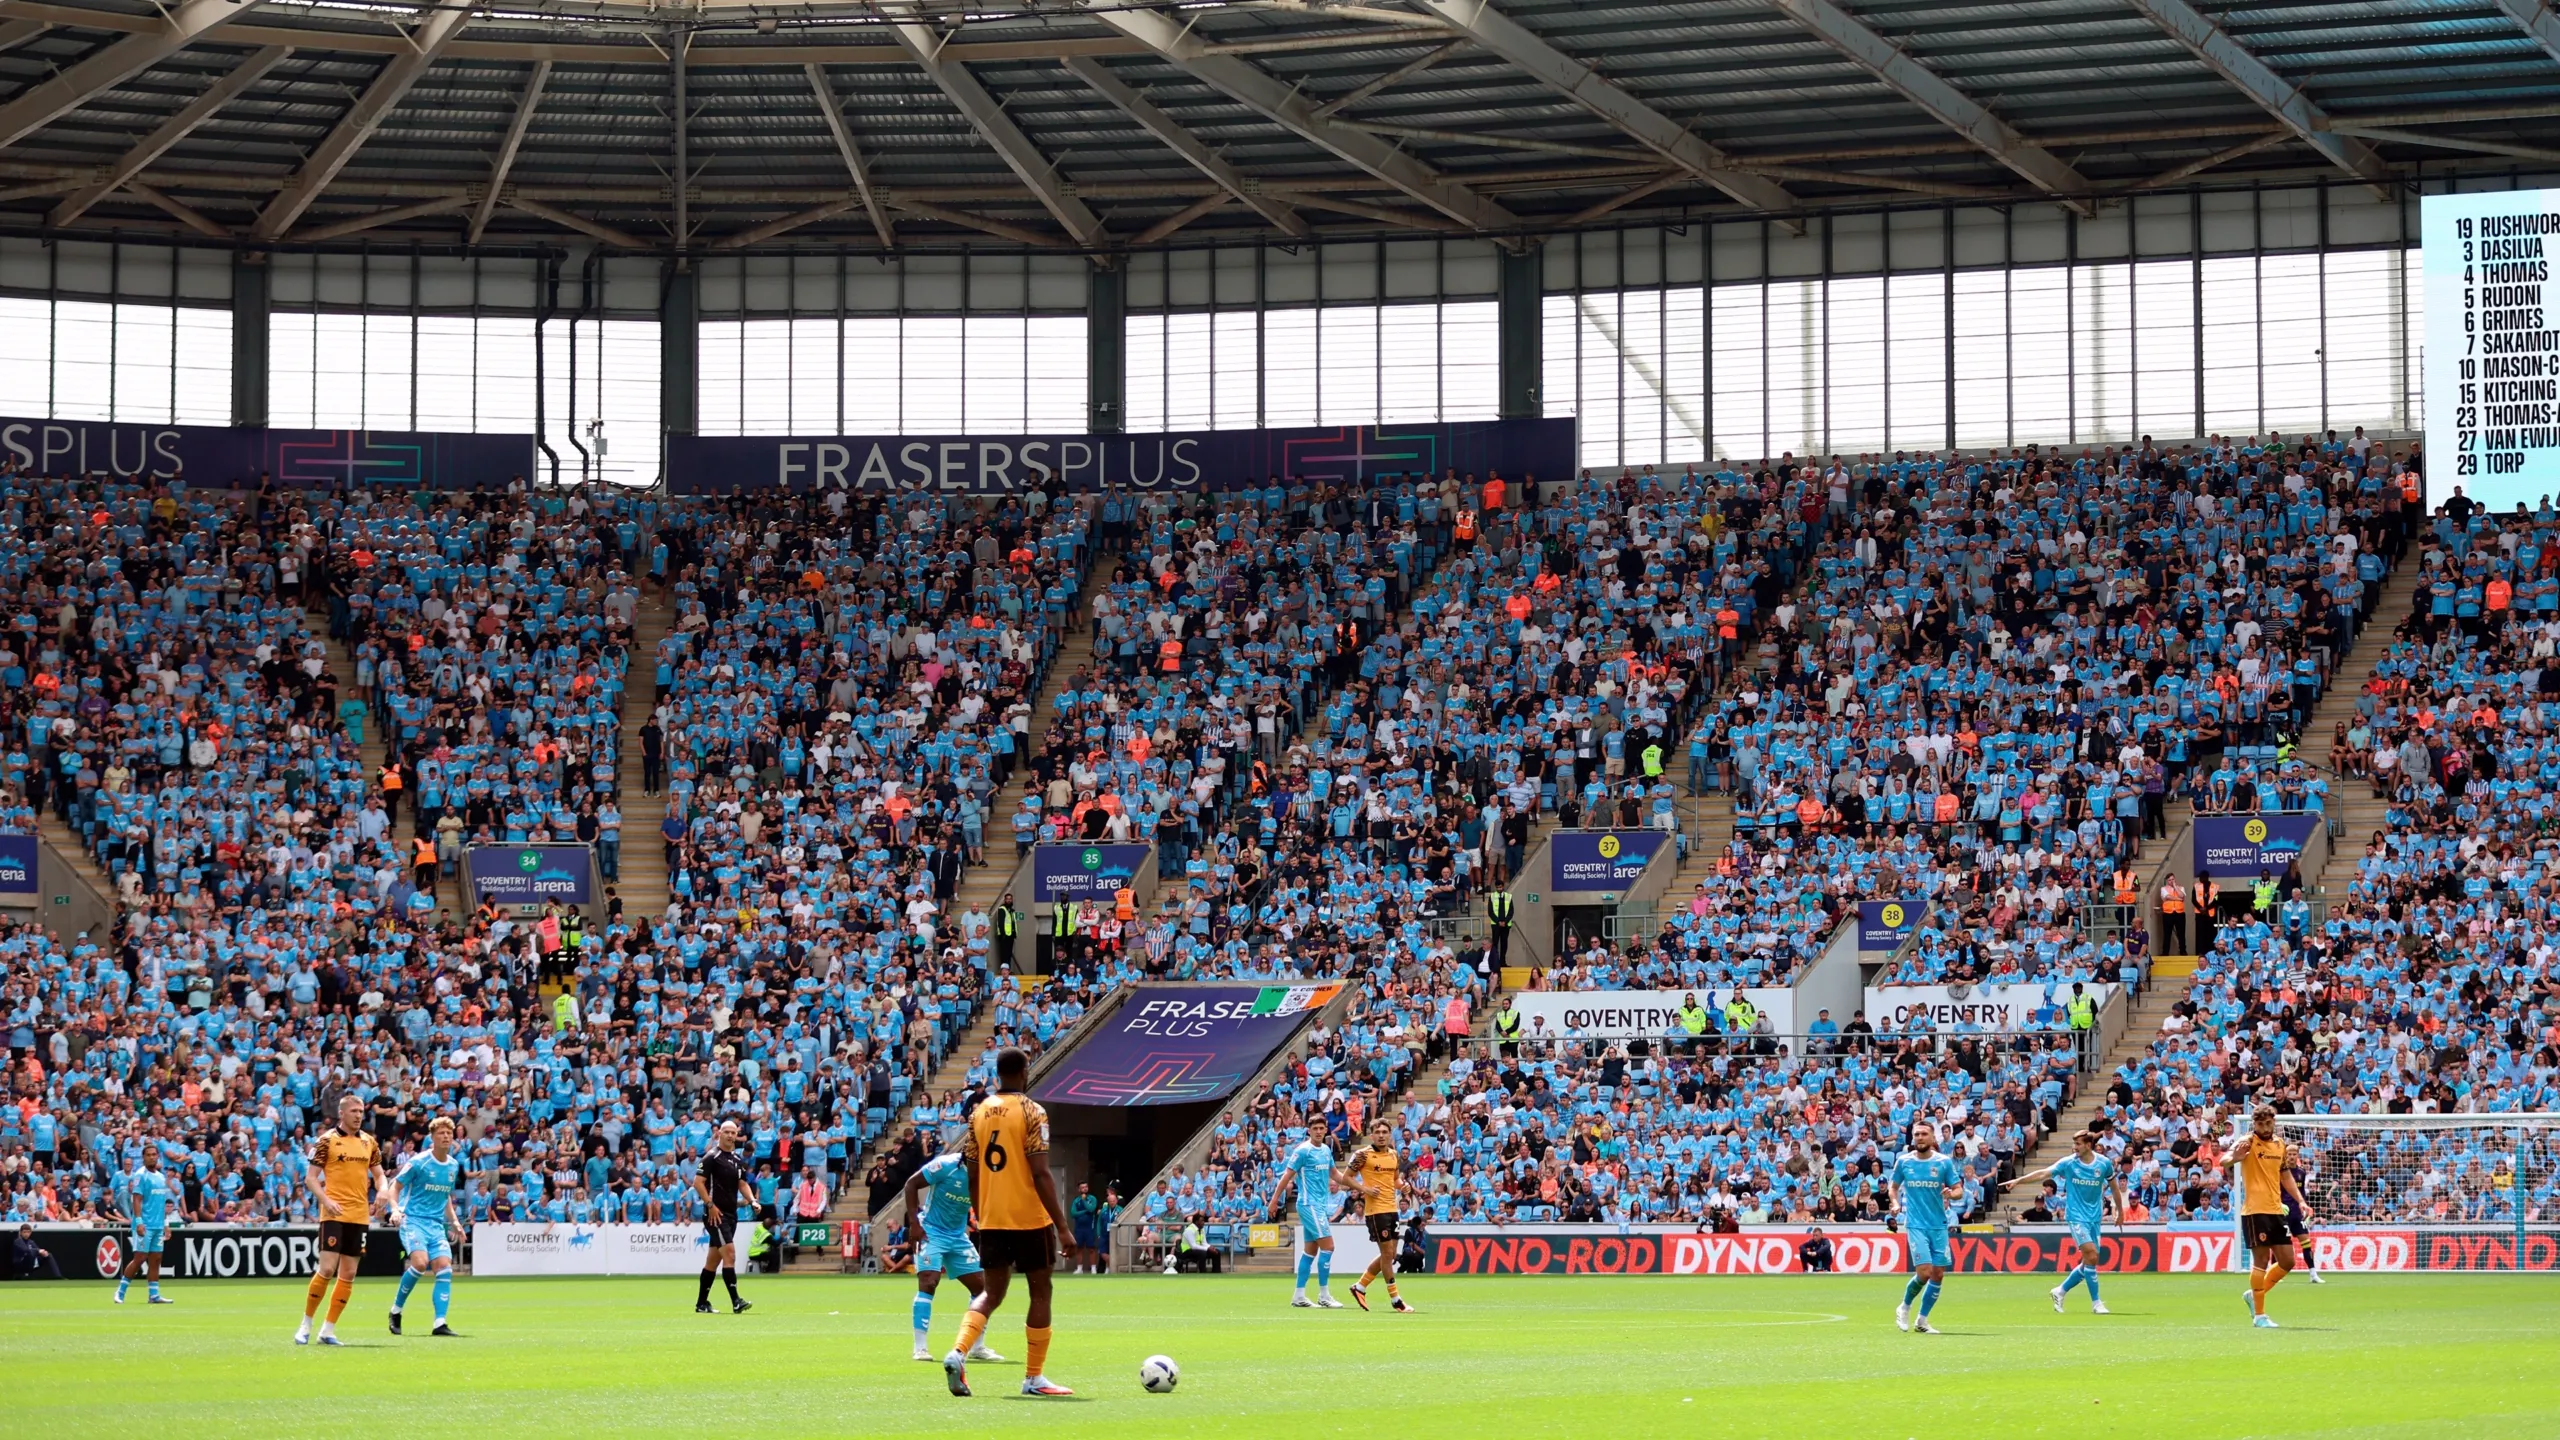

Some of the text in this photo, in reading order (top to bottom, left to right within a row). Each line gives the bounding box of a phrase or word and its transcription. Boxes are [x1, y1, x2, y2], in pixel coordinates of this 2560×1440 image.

[2456, 213, 2560, 239] 19 RUSHWOR
[2463, 237, 2544, 262] 3 DASILVA
[2463, 260, 2548, 285] 4 THOMAS
[2464, 284, 2541, 309] 5 RUDONI
[2464, 307, 2544, 332] 6 GRIMES
[2466, 330, 2560, 355] 7 SAKAMOT
[2459, 354, 2559, 380] 10 MASON-C
[2459, 379, 2557, 404] 15 KITCHING
[2456, 406, 2476, 428] 23
[2458, 426, 2560, 451] 27 VAN EWIJ
[2457, 452, 2525, 476] 29 TORP
[2248, 826, 2263, 836] 39
[1603, 841, 1616, 852] 37
[522, 856, 537, 866] 34
[1085, 853, 1099, 864] 35
[2206, 848, 2298, 863] COVENTRY aren
[2206, 857, 2253, 866] Building Society
[1563, 863, 1607, 872] COVENTRY
[1046, 875, 1089, 883] COVENTRY
[1563, 872, 1607, 880] Building Society
[481, 876, 576, 893] COVENTRY arena
[481, 885, 527, 894] Building Society
[1046, 883, 1089, 891] Building Society
[1885, 910, 1900, 920] 38
[1139, 1001, 1295, 1019] FRASE
[1895, 1004, 2009, 1023] CVENTRY
[1564, 1009, 1674, 1028] COVENTRY
[1123, 1018, 1213, 1037] PLUS
[985, 1130, 1007, 1172] 6
[2072, 1178, 2100, 1186] monzo
[361, 1232, 368, 1248] 5
[507, 1233, 560, 1243] COVENTRY
[630, 1233, 686, 1243] COVENTRY
[802, 1229, 826, 1241] P28
[1252, 1230, 1276, 1242] P29
[507, 1244, 560, 1254] Building Society
[630, 1244, 686, 1254] Building Society
[1435, 1238, 1656, 1274] DYNO-ROD
[1673, 1237, 1900, 1273] DYNO-OD
[1950, 1237, 2150, 1273] YNO-ROD
